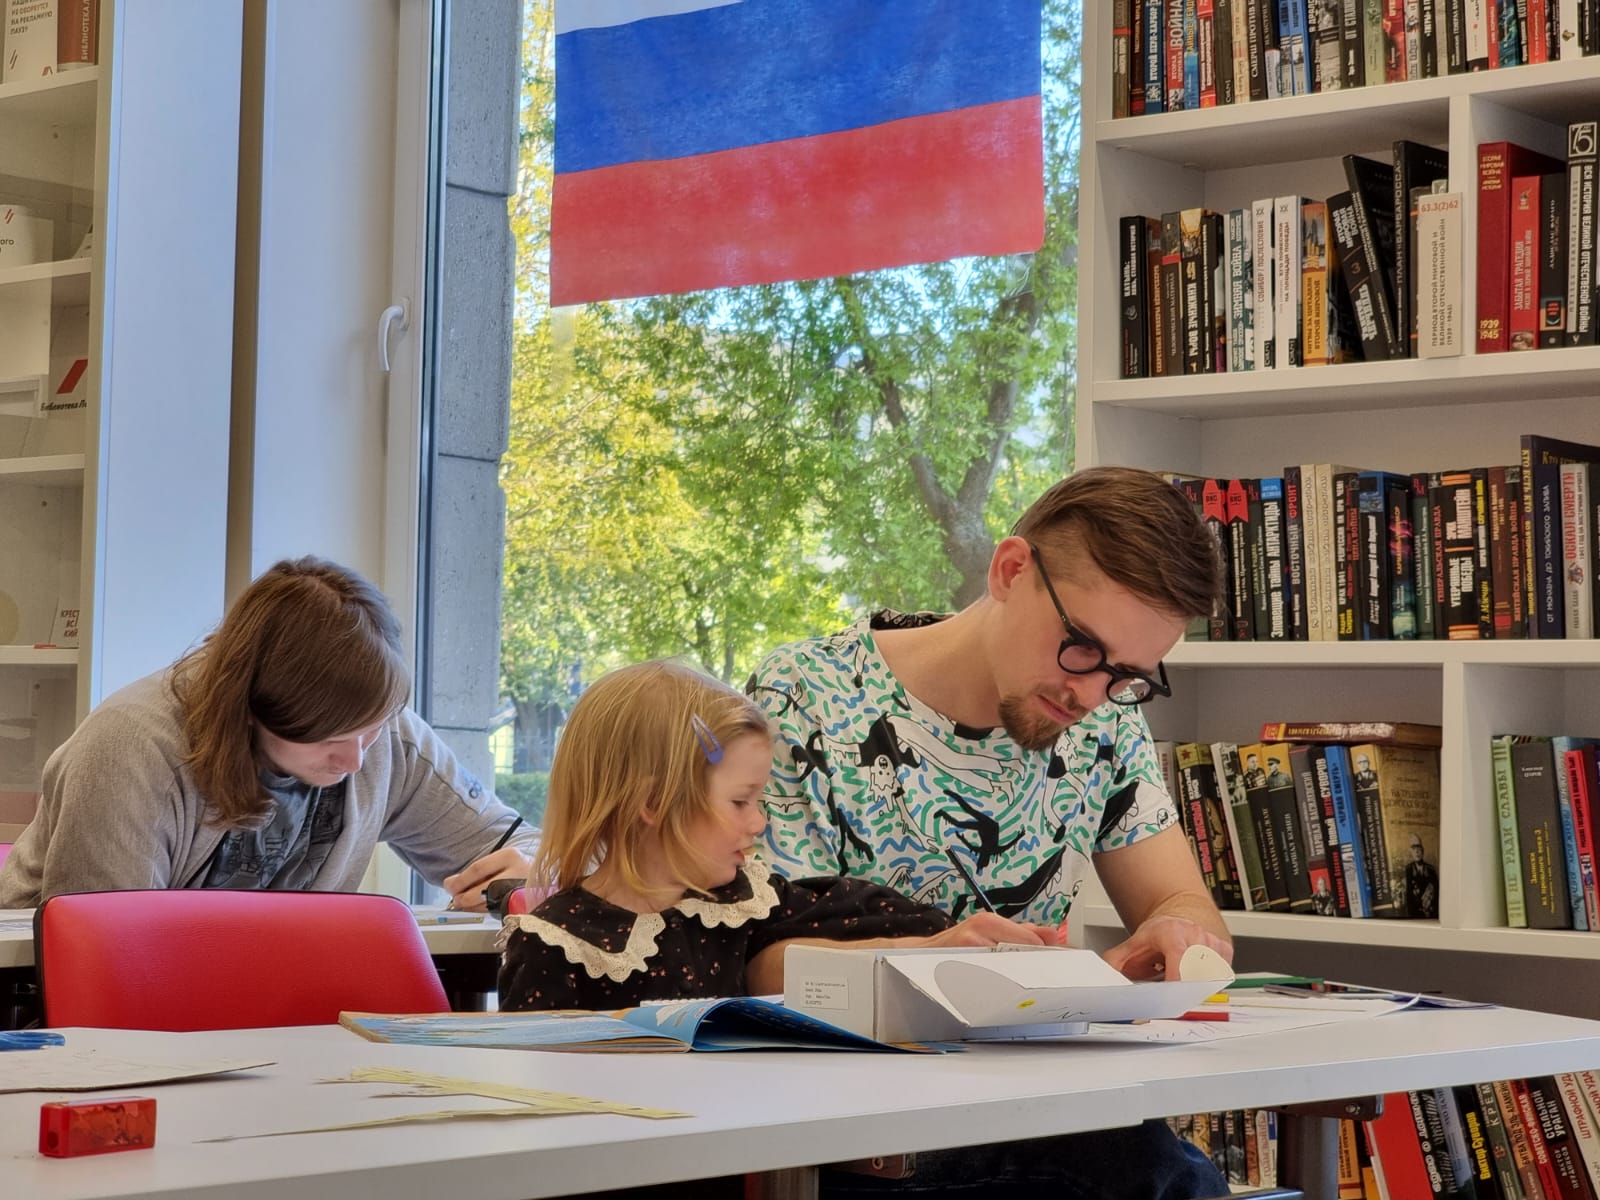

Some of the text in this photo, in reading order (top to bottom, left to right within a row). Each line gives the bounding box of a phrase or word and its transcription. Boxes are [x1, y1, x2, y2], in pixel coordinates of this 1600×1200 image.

[1168, 0, 1184, 48] ВОЙНА
[1345, 30, 1357, 39] ОТ
[1248, 7, 1258, 77] СМЕРШ ПРОТИВ
[1148, 54, 1158, 81] ВТОРОЙ
[1584, 165, 1593, 180] ВСЯ
[1583, 181, 1593, 214] ИСТОРИЯ
[1332, 210, 1346, 243] ВТОРАЯ
[1339, 208, 1354, 248] МИРОВАЯ
[1582, 216, 1593, 249] ВЕЛИКОЙ
[1230, 245, 1242, 277] ВОЙНА
[1233, 281, 1242, 319] ЗИМНЯЯ
[1514, 278, 1523, 310] ЗАБЫТАЯ
[1187, 283, 1199, 357] КНИЖНЫЕ ВОРЫ
[1480, 319, 1500, 329] 1939
[1480, 330, 1500, 339] 1945
[1579, 306, 1591, 332] ВОЙНЫ
[1521, 449, 1532, 512] КТО ЕСТЬ КТО
[1287, 484, 1297, 518] ФРОНТ
[1453, 488, 1472, 539] МАНШТЕЙН
[1542, 484, 1550, 513] ЗАЛИВА
[1264, 502, 1280, 557] АНТАРКТИДЫ
[1562, 472, 1577, 560] ОСКАЛ СМЕРТИ
[1289, 524, 1300, 585] ВОСТОЧНЫЙ
[1352, 538, 1360, 560] ЦЕНА
[1414, 535, 1422, 562] ГВАРДИЯ
[1434, 505, 1444, 603] ГЕНЕРАЛЬСКАЯ ПРАВДА
[1510, 501, 1521, 621] ЖИТЕЙСКАЯ ПРАВДА ВОЙНЫ
[1268, 560, 1281, 588] тайны
[1338, 571, 1346, 586] 1941
[1449, 558, 1461, 607] УТЕРЯННЫЕ
[1460, 556, 1475, 592] ПОБЕДЫ
[1545, 562, 1552, 573] ДО
[1270, 591, 1284, 638] Зловещие
[1547, 613, 1554, 623] ОТ
[1302, 771, 1325, 856] МАРШАЛ ВАСИЛЕВСКИЙ
[1497, 769, 1518, 892] НЕ РАДИ СЛАВЫ
[1190, 801, 1213, 873] КРАСНАЯ АРМИЯ
[1325, 817, 1339, 846] Новый
[1289, 842, 1300, 876] МАРШАЛ
[1529, 852, 1538, 884] Записки
[1518, 1094, 1548, 1164] СОВЕТСКО-ФИНСКАЯ
[1531, 1090, 1556, 1139] СТАЛЬНОЙ
[1547, 1100, 1566, 1137] УРАГАН
[1565, 1089, 1592, 1139] ШТРАФНОЙ
[1466, 1112, 1492, 1180] Виктор Суворов
[1514, 1128, 1525, 1143] ПОД
[1519, 1143, 1530, 1165] БИТВА
[1554, 1149, 1568, 1177] ВИКТОР
